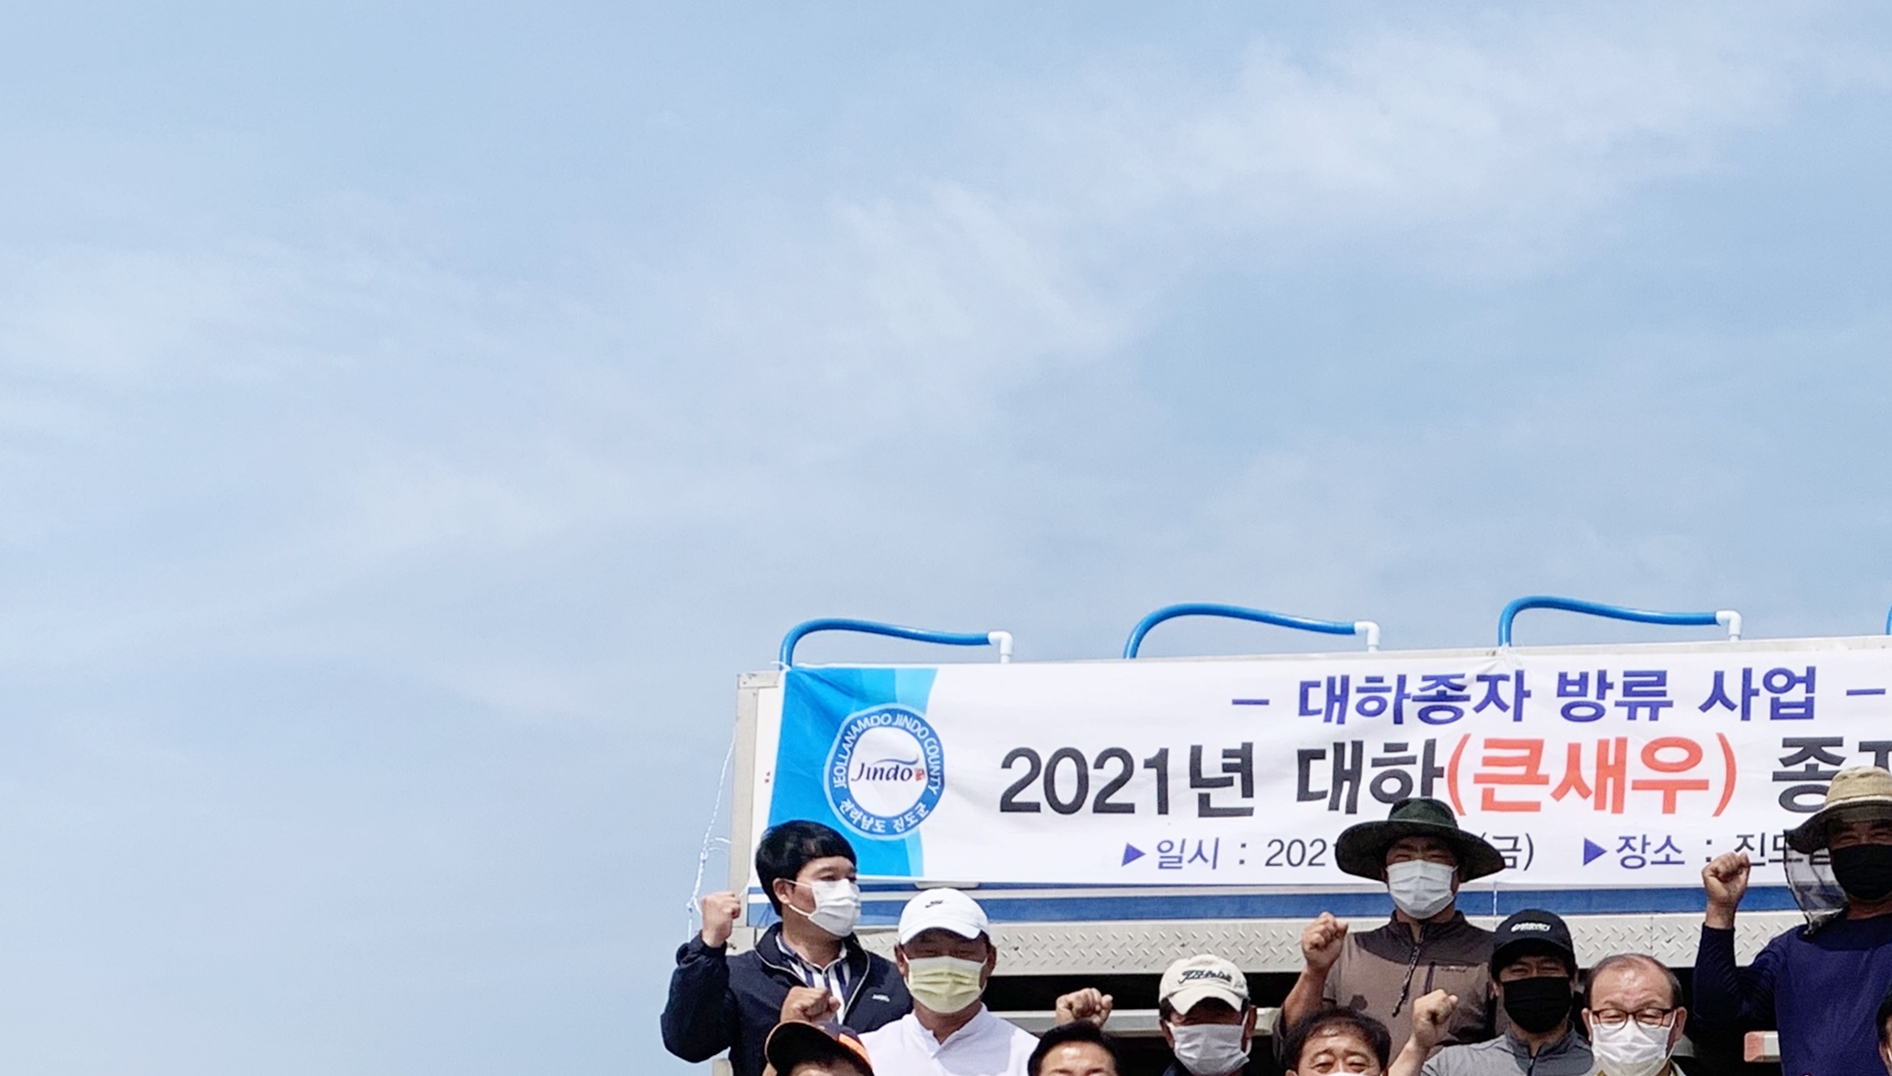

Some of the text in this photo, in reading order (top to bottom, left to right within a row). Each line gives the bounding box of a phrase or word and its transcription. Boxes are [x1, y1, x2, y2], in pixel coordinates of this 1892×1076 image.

[1298, 669, 1532, 725] 대하종자
[1556, 669, 1674, 723] 방류
[1698, 665, 1817, 721] 사업
[833, 713, 941, 795] JEOLLANAMDO JINDO COUNTY
[851, 762, 913, 782] Jindo
[1000, 742, 1254, 818] 2021년
[1297, 732, 1737, 817] 대하(큰새우)
[839, 798, 929, 833] 전라남도 진도군
[1157, 837, 1219, 870] 일시
[1264, 838, 1338, 867] 202
[1616, 834, 1685, 869] 장소
